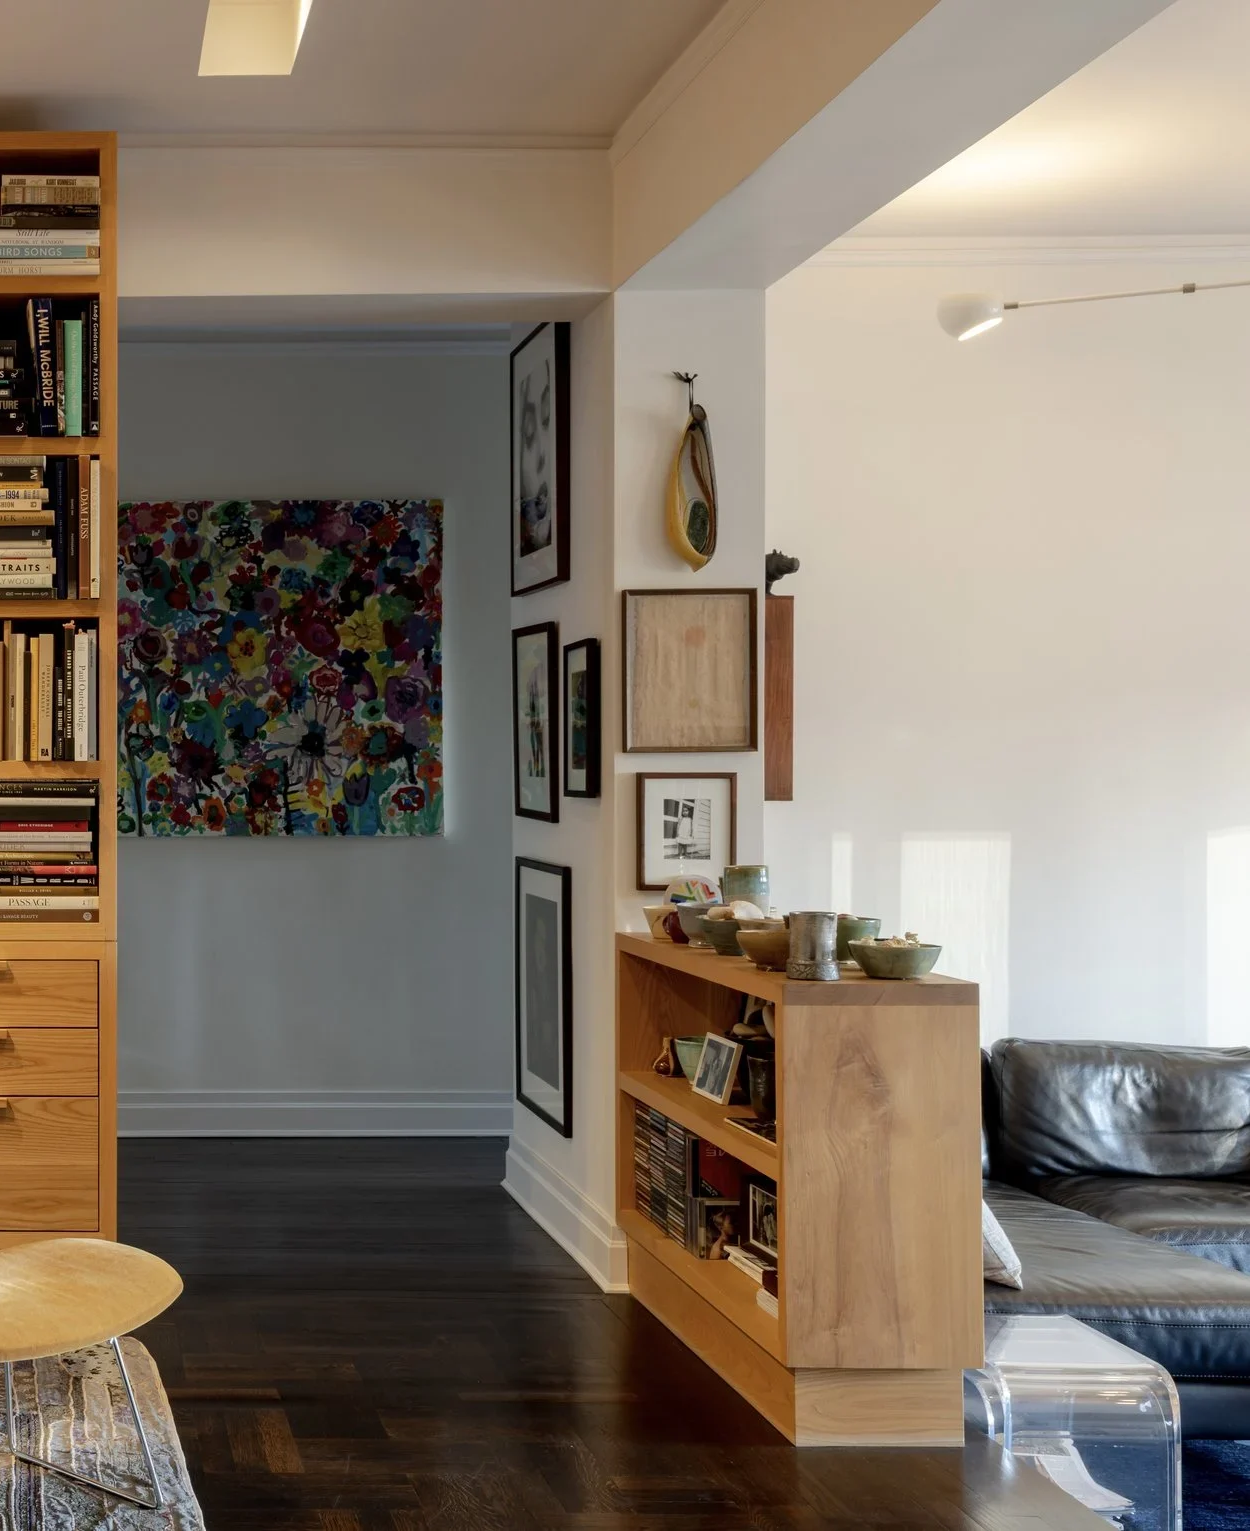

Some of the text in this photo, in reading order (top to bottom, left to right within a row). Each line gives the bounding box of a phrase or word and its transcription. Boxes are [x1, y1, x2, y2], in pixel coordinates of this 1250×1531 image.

[25, 248, 62, 256] SONGS
[81, 487, 89, 539] ADAM FUSS
[77, 665, 86, 732] Paul Outerbridge
